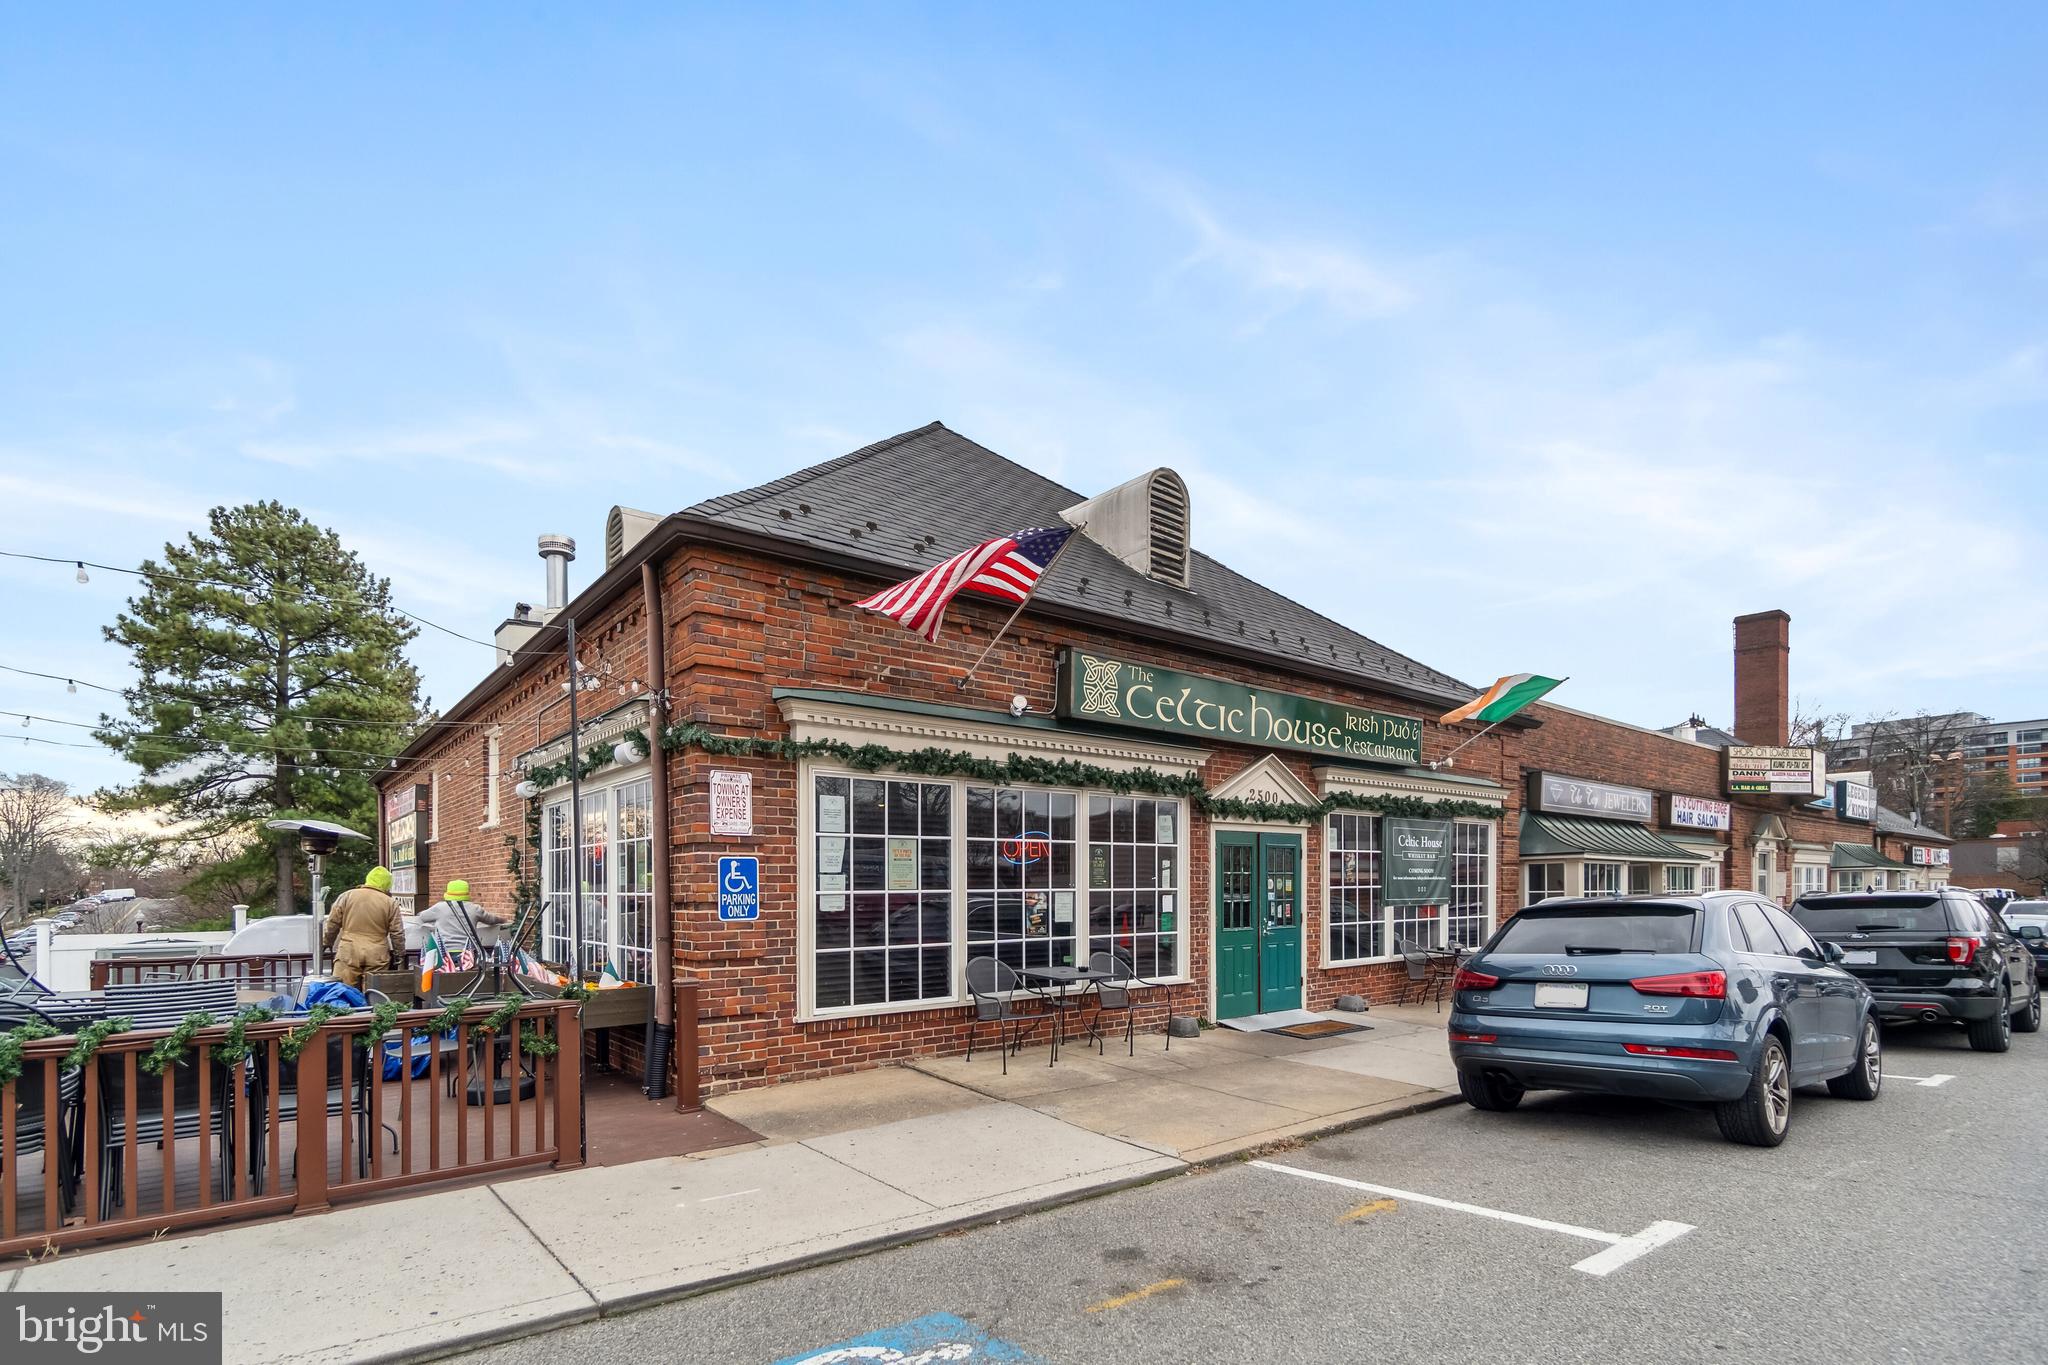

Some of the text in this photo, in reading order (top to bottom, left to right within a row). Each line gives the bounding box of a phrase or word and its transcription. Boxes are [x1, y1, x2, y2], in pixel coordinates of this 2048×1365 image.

[1128, 665, 1154, 682] The
[1126, 685, 1245, 733] Celtic
[1733, 748, 1809, 758] SHOPS ON LOWER LEVEL
[1772, 760, 1786, 769] KUNG
[713, 783, 749, 796] TOWING AT
[1249, 788, 1278, 804] 2500
[716, 796, 747, 808] OWNER'S
[1603, 791, 1648, 813] JEWELERS
[1687, 797, 1713, 813] CUTTING
[1713, 802, 1728, 815] EDGE
[716, 808, 747, 820] EXPENSE
[1676, 811, 1719, 828] HAIR SALON
[1398, 834, 1443, 848] Celtic House
[1003, 840, 1050, 858] OPEN
[721, 893, 756, 906] PARKING
[727, 905, 750, 917] ONLY
